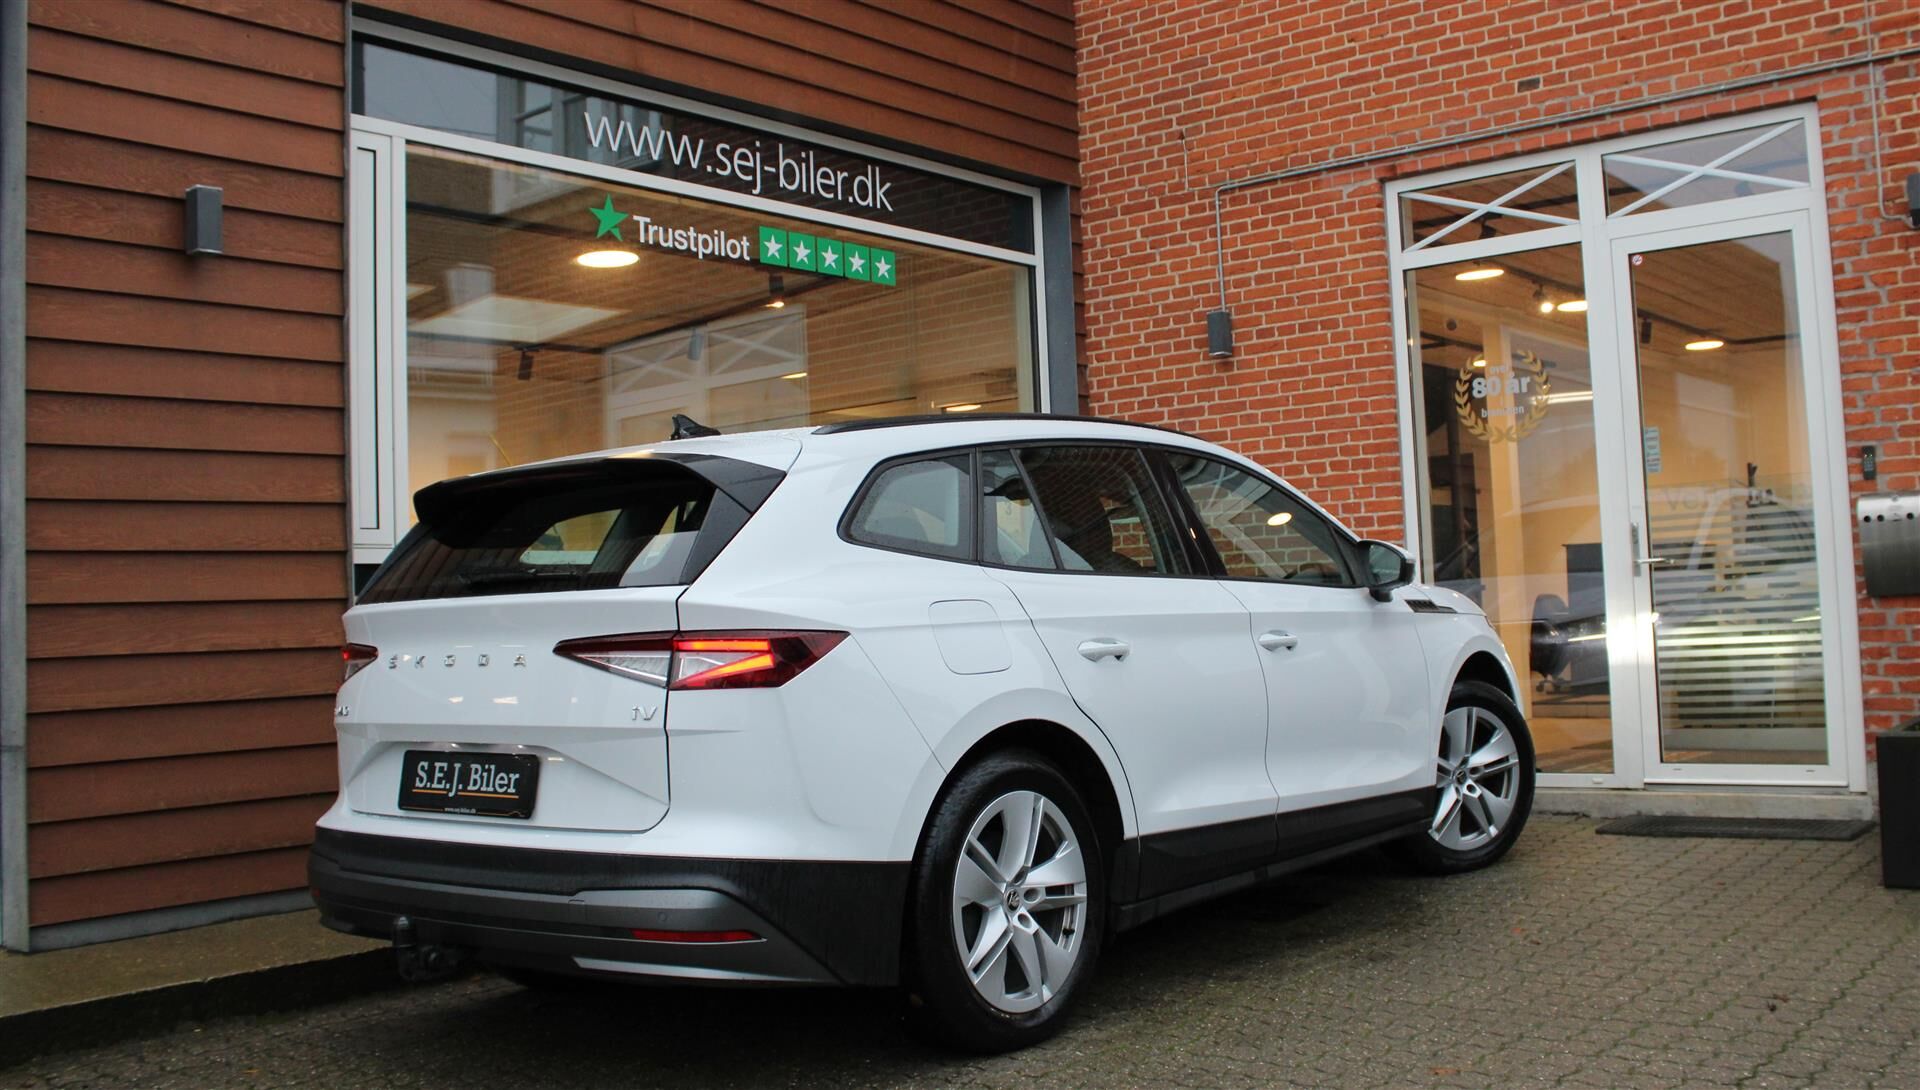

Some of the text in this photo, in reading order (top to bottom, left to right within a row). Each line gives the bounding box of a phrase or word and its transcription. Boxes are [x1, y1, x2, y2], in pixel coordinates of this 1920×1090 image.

[584, 111, 893, 211] www.sej-biler.dk
[633, 215, 750, 261] Trustpilot
[1472, 377, 1501, 399] 80
[415, 761, 520, 797] S.E.J. Biler
